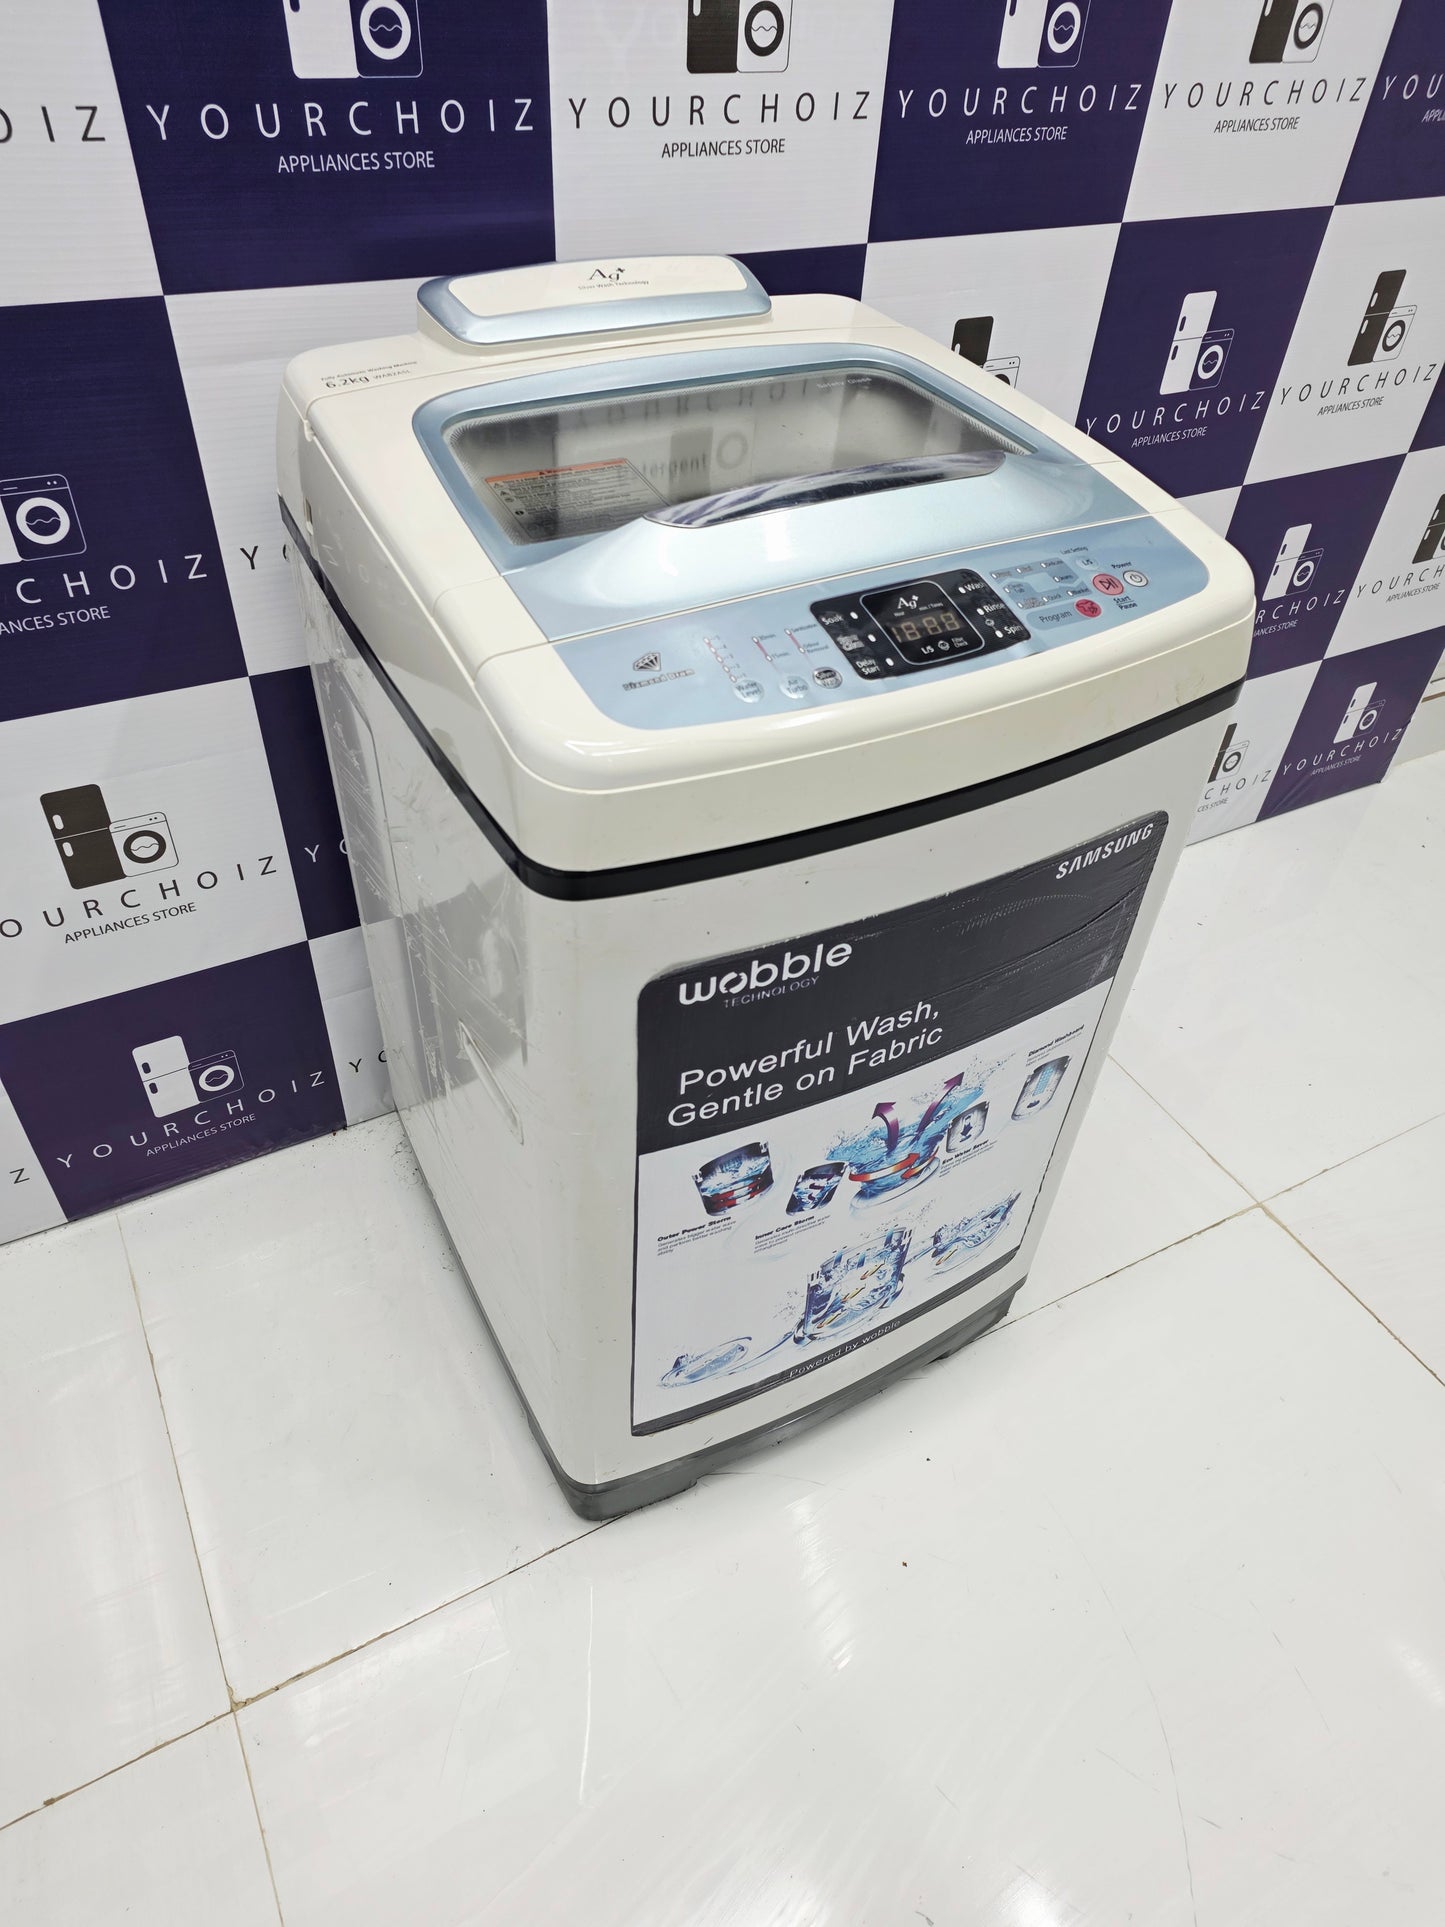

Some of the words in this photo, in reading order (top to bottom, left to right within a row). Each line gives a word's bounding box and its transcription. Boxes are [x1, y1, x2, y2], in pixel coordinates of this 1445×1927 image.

[1213, 118, 1269, 133] APPLIANCES
[1270, 116, 1301, 131] STORE
[966, 127, 1032, 145] APPLIANCES
[1033, 126, 1068, 141] STORE
[661, 140, 742, 158] APPLIANCES
[745, 138, 786, 155] STORE
[278, 152, 380, 173] APPLIANCES
[384, 150, 435, 170] STORE
[325, 376, 370, 389] 6.2kg
[1316, 398, 1361, 416] APPLIANCES
[1361, 395, 1385, 408] STORE
[1131, 429, 1180, 448] APPLIANCES
[1180, 426, 1208, 442] STORE
[1111, 560, 1132, 570] Power
[965, 581, 986, 592] Wash
[983, 602, 1005, 614] Rinse
[1112, 595, 1131, 604] Start
[57, 605, 111, 626] STORE
[820, 614, 843, 626] Soak
[1039, 610, 1073, 624] Program
[1004, 624, 1023, 637] Spin
[855, 657, 876, 669] Delay
[861, 665, 880, 676] Start
[1055, 823, 1154, 880] SAMSUNG
[64, 913, 150, 944] APPLIANCES
[152, 901, 197, 921] STORE
[678, 942, 853, 1006] wobble
[724, 975, 819, 1008] TECHNOLOGY
[679, 1031, 833, 1095] Powerful
[846, 1001, 939, 1047] Wash,
[667, 1083, 784, 1127] Gentle
[796, 1066, 835, 1092] on
[848, 1027, 944, 1075] Fabric
[146, 1127, 217, 1157] APPLIANCES
[219, 1112, 256, 1132] STORE
[657, 1231, 680, 1242] Outer
[681, 1223, 706, 1235] Power
[708, 1216, 732, 1227] Storm
[755, 1230, 774, 1241] Inner
[775, 1223, 793, 1233] Care
[794, 1215, 815, 1226] Storm
[789, 1348, 841, 1378] Powered
[845, 1341, 860, 1354] by
[862, 1320, 902, 1345] wobble
